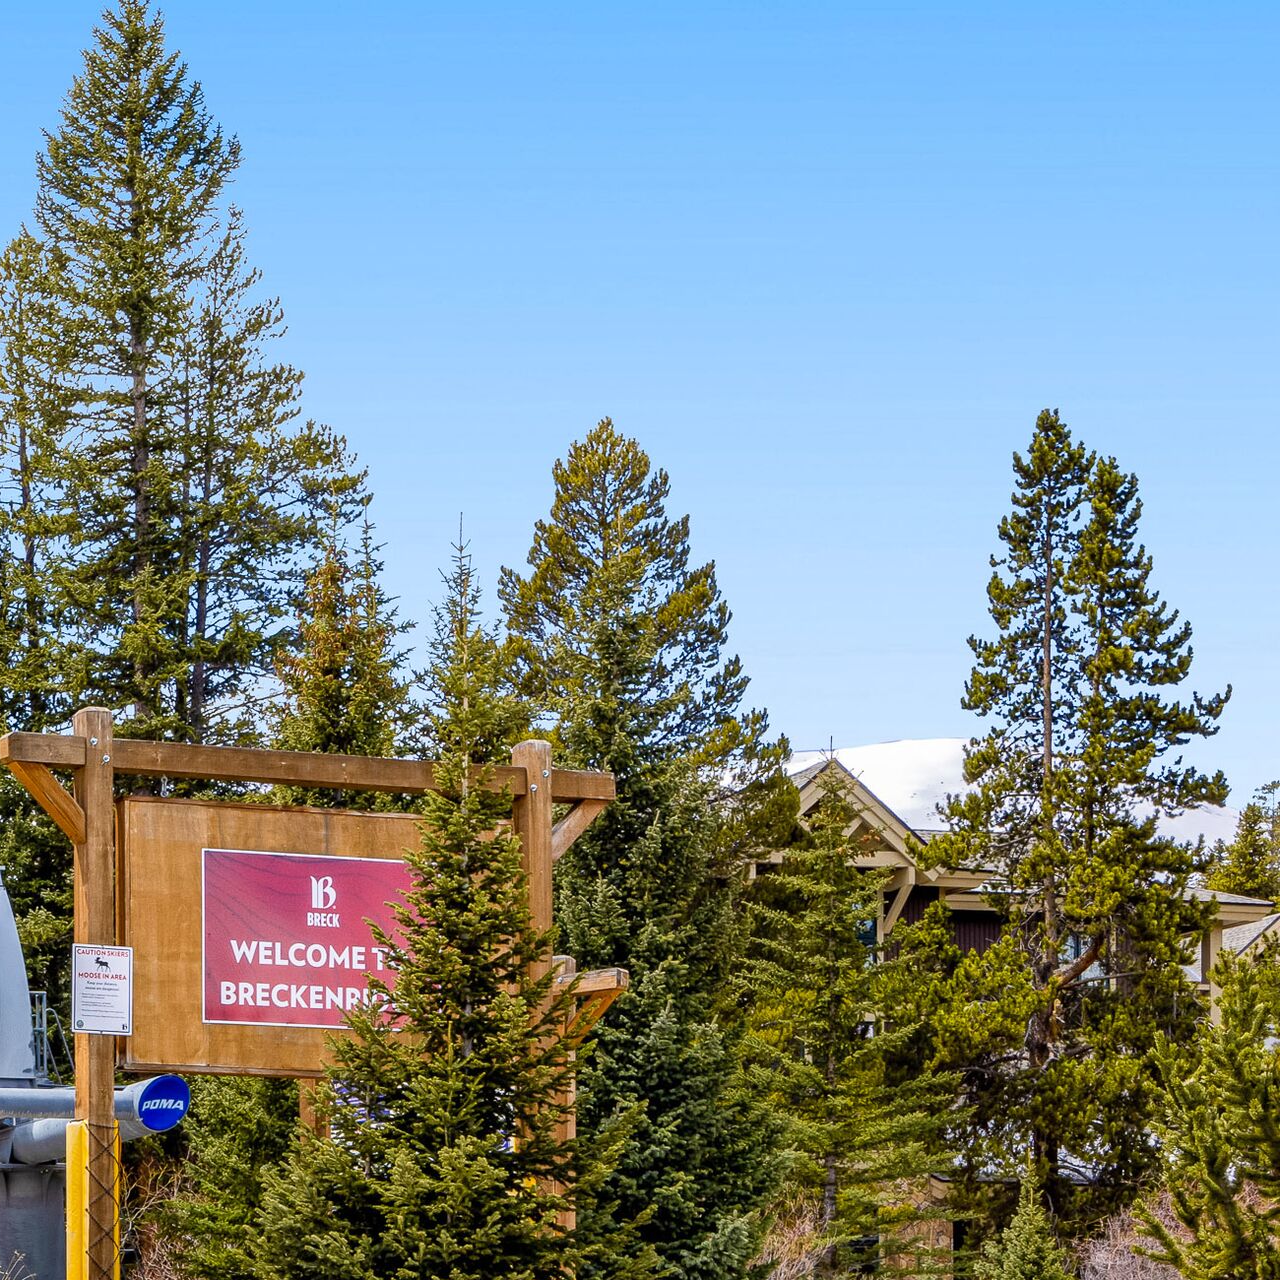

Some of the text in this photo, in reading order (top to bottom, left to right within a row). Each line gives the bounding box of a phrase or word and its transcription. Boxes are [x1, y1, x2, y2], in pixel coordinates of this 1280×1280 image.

[307, 912, 340, 928] BRECK
[77, 948, 106, 956] CAUTION
[230, 939, 366, 970] WELCOME
[142, 1098, 184, 1112] POMA
